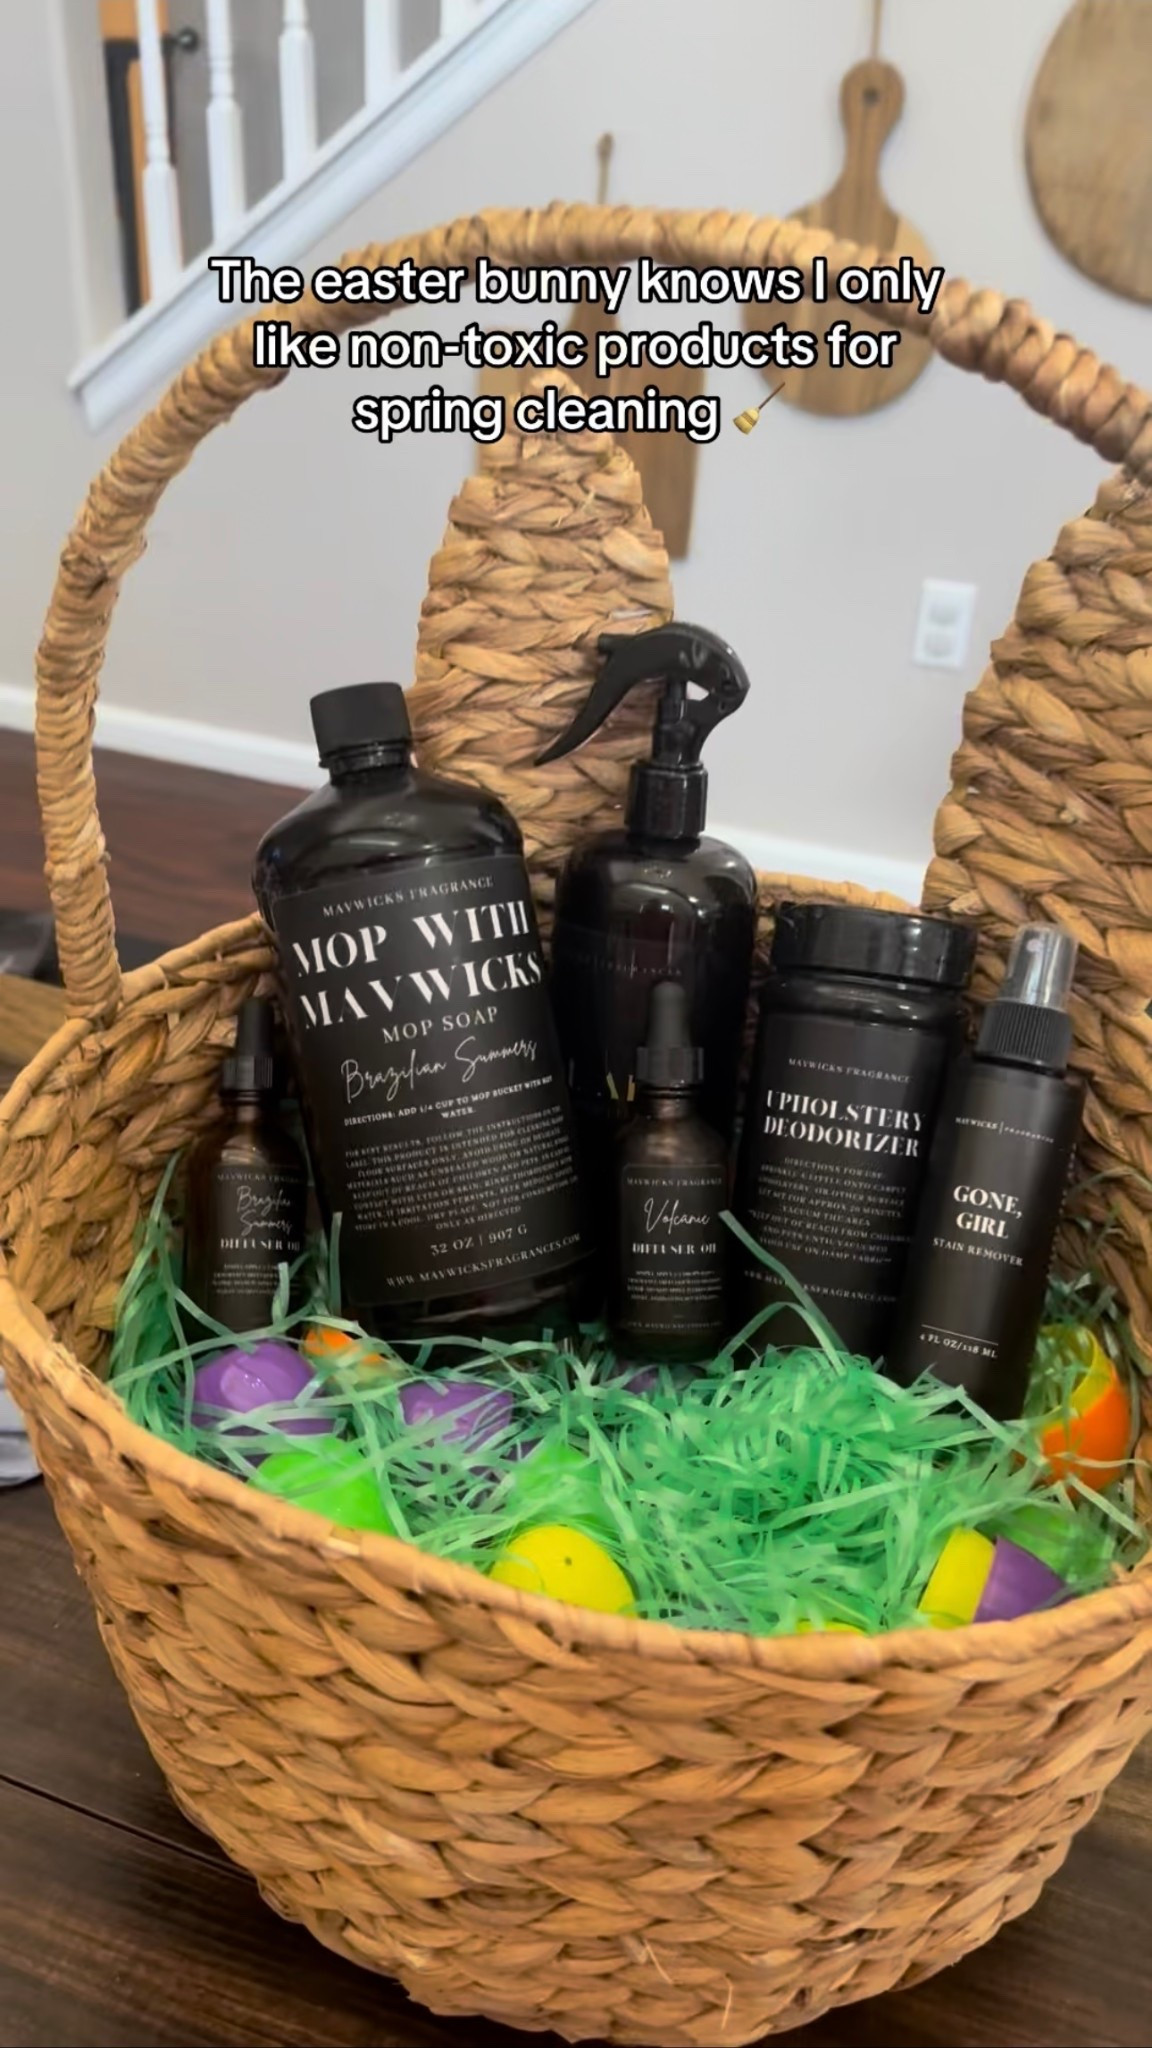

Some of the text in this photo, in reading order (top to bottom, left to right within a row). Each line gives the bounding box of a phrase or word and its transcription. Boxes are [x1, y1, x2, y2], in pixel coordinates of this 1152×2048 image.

[323, 877, 494, 916] MAVWICKS FRAGRANCE
[292, 900, 529, 977] MOP WITH
[299, 950, 541, 1031] MAVWICKS
[382, 1006, 497, 1043] MOP SOAP
[340, 1035, 539, 1106] Brazilian Summers
[344, 1110, 395, 1126] DIRECTIONS:
[398, 1107, 417, 1117] ADD
[435, 1099, 454, 1110] CUP
[456, 1096, 469, 1105] TO
[471, 1091, 490, 1102] MOP
[492, 1083, 522, 1097] BUCKET
[441, 1106, 474, 1118] WATER.
[767, 1090, 925, 1131] UPHOLSTERY
[764, 1116, 918, 1156] DEODORIZER
[644, 1197, 709, 1235] Volcanic
[953, 1185, 1022, 1218] GONE,
[430, 1224, 527, 1256] 32 OZ 907 G
[956, 1212, 1009, 1238] GIRL
[632, 1243, 695, 1255] DIFFUSER
[933, 1238, 1022, 1265] STAIN REMOVER
[928, 1334, 940, 1344] FL
[981, 1347, 998, 1358] ML
